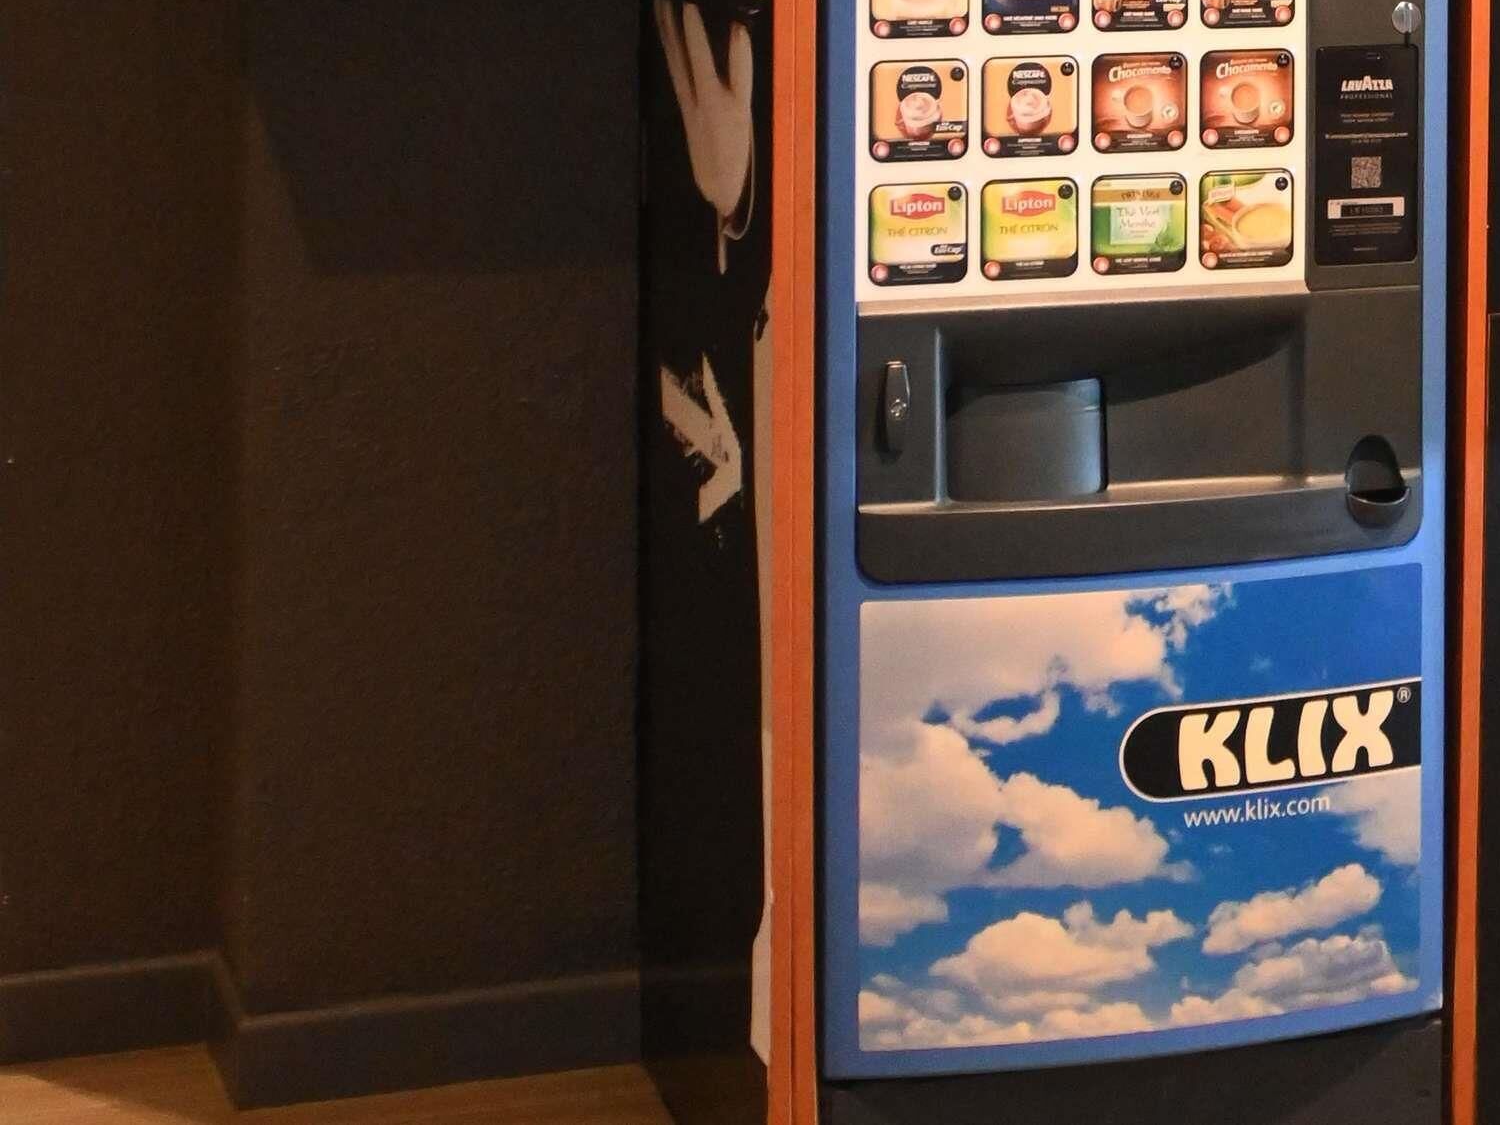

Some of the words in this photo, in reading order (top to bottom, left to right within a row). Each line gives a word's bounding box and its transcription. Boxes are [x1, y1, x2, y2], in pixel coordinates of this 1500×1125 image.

[1341, 75, 1393, 92] LAVAZZA
[893, 198, 944, 216] Lipton
[1003, 196, 1053, 214] Lipton
[908, 226, 947, 236] CITRON
[1021, 224, 1058, 233] CITRON
[1178, 690, 1394, 790] KLIX
[1184, 796, 1330, 828] www.klix.com
